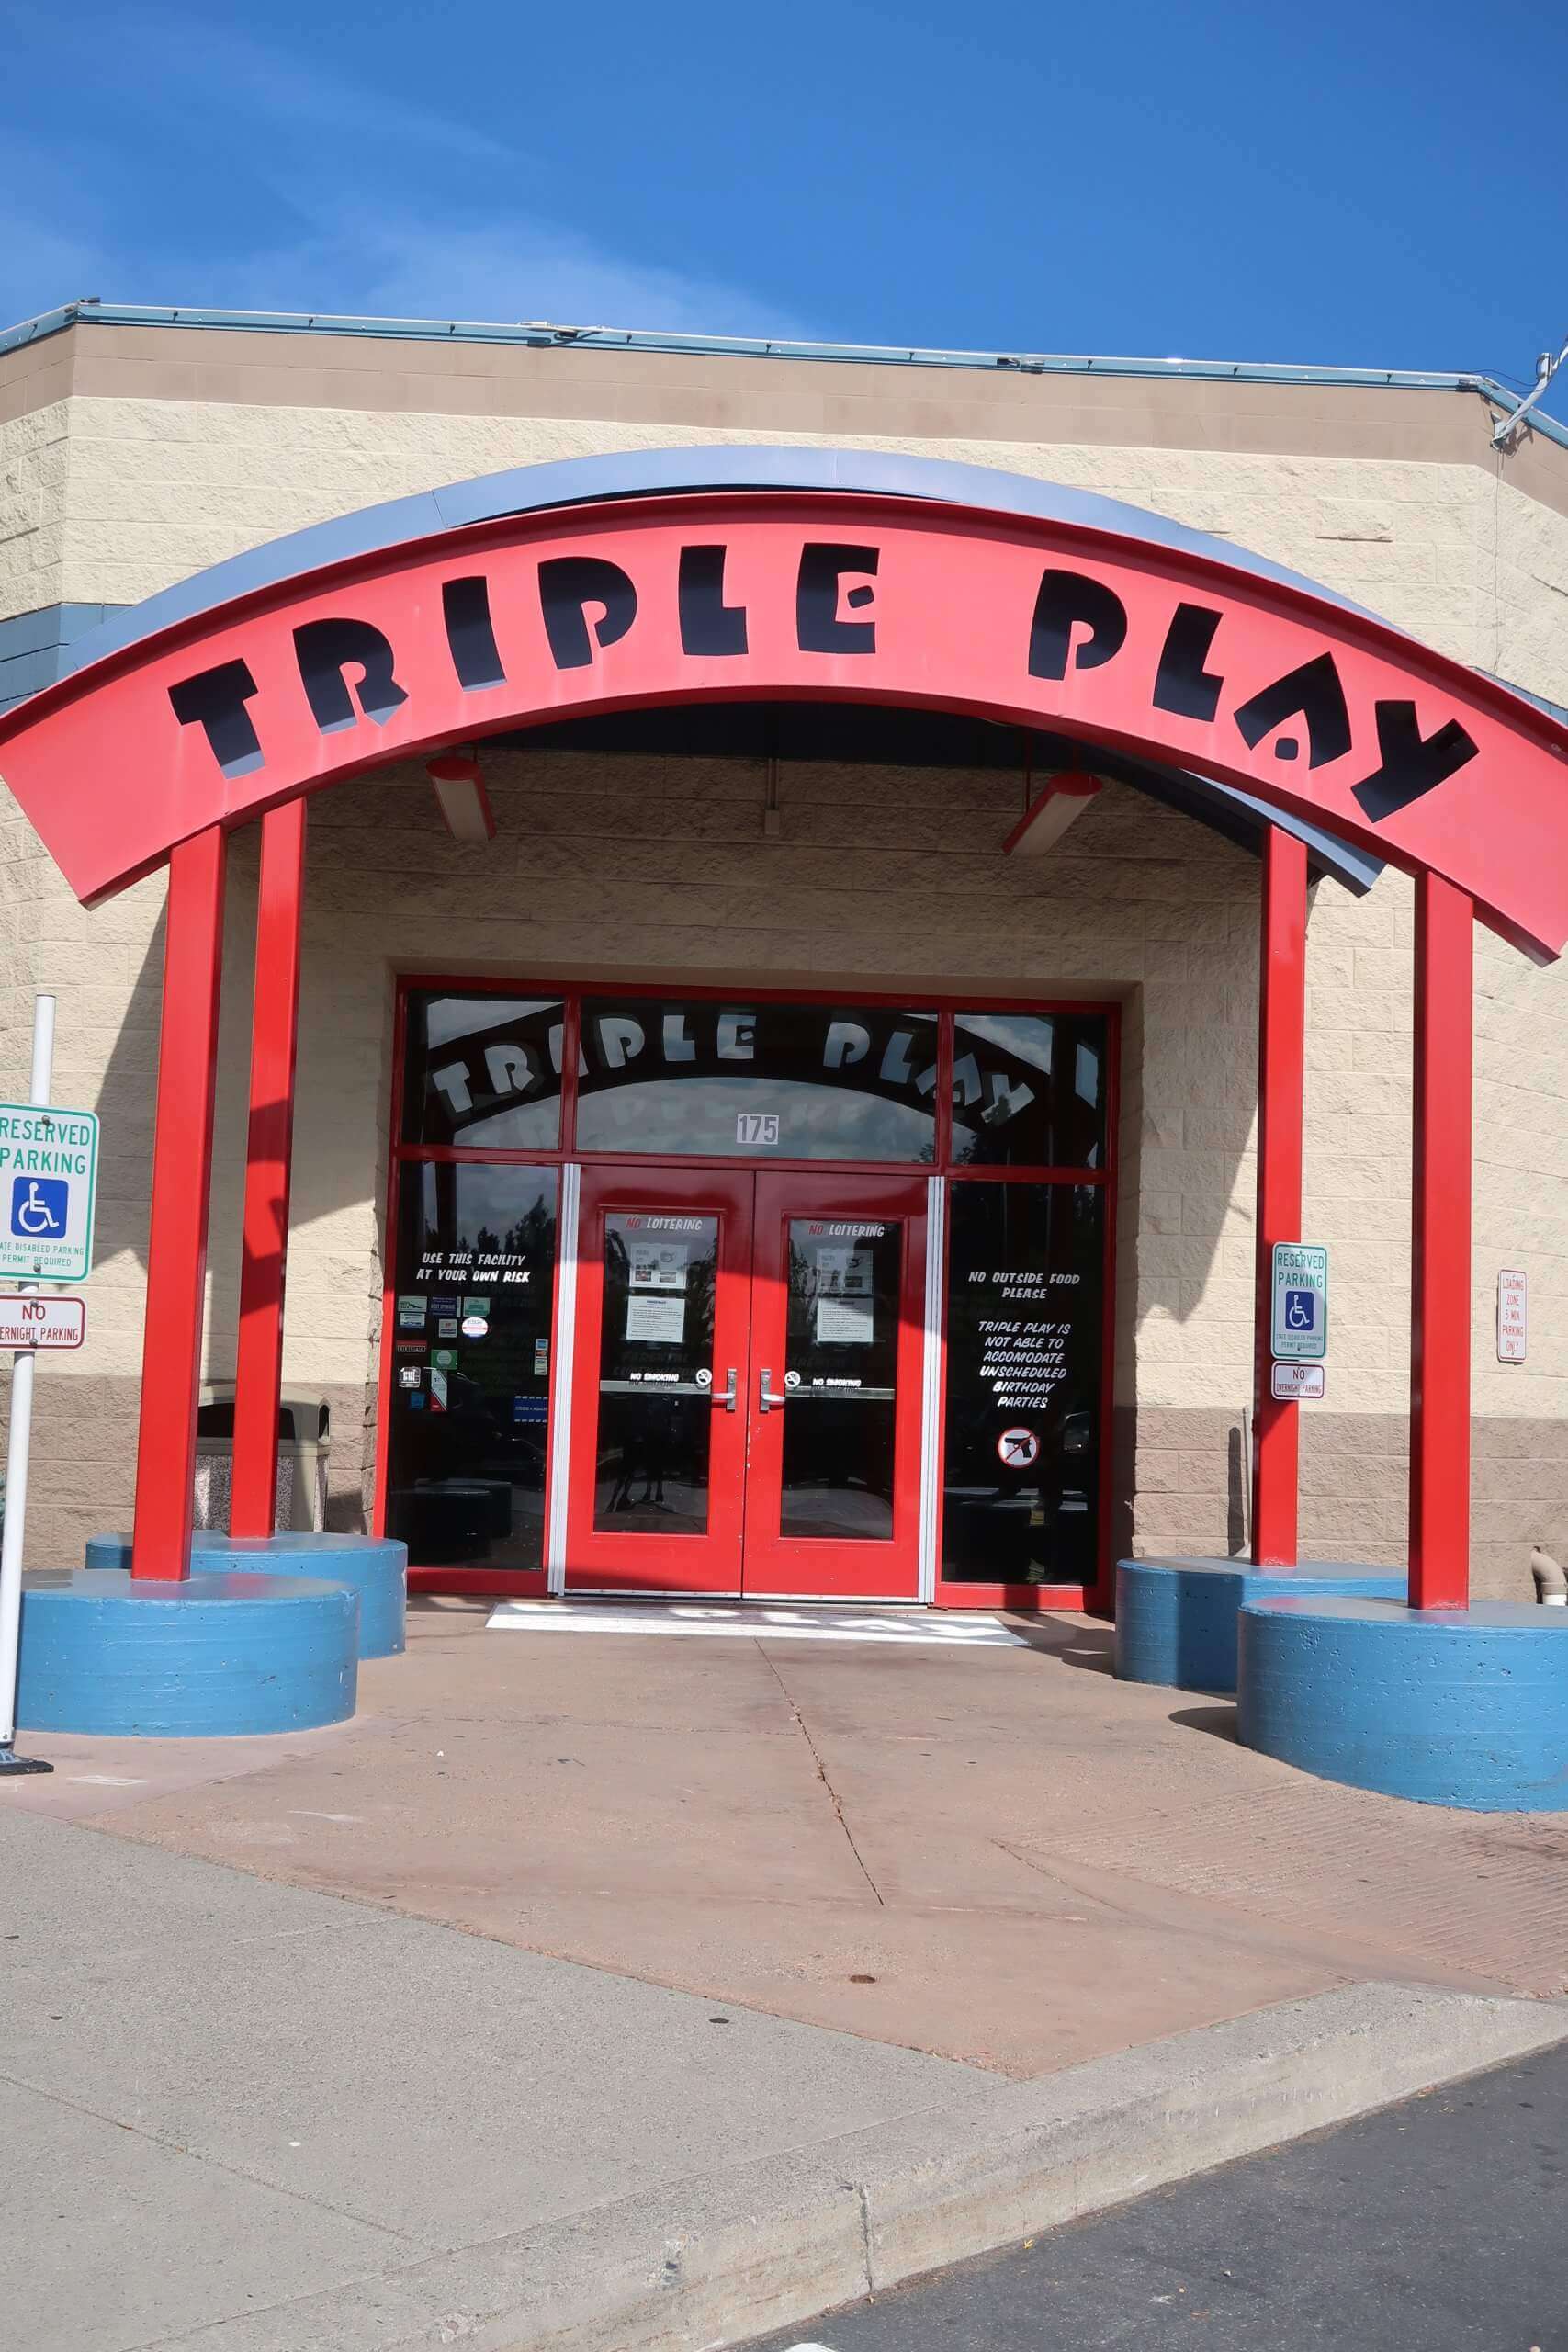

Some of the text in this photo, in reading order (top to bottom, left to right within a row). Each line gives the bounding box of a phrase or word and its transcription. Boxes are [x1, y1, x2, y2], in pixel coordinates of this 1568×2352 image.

[167, 542, 1480, 824] TRIPLE PLAY
[0, 1116, 90, 1146] RESERVED
[739, 1115, 778, 1143] 175
[0, 1147, 86, 1174] PARKING
[626, 1217, 703, 1231] NO LOITERING
[808, 1224, 885, 1237] NO LOITERING
[16, 1243, 51, 1253] DISABLED
[53, 1246, 84, 1256] PARKING
[2, 1253, 72, 1267] PERMIT REQUIRED
[422, 1252, 526, 1266] USE THIS FACILITY
[1277, 1252, 1325, 1269] RESERVED
[416, 1269, 530, 1283] AT YOUR OWN RISK
[968, 1272, 1080, 1285] NO OUTSIDE FOOD
[1278, 1272, 1323, 1288] PARKING
[1002, 1287, 1047, 1299] PLEASE
[22, 1305, 46, 1320] NO
[0, 1326, 78, 1341] ERNIGHT PARKING
[978, 1321, 1071, 1334] TRIPLE PLAY IS
[985, 1336, 1064, 1350] NOT ABLE TO
[983, 1351, 1065, 1363] ACCOMODATE
[630, 1373, 680, 1383] NO SMOKING
[979, 1366, 1067, 1379] UNSCHEDULED
[1292, 1369, 1305, 1380] NO
[812, 1378, 862, 1388] NO SMOKING
[992, 1381, 1055, 1394] BIRTHDAY
[997, 1396, 1048, 1408] PARTIES
